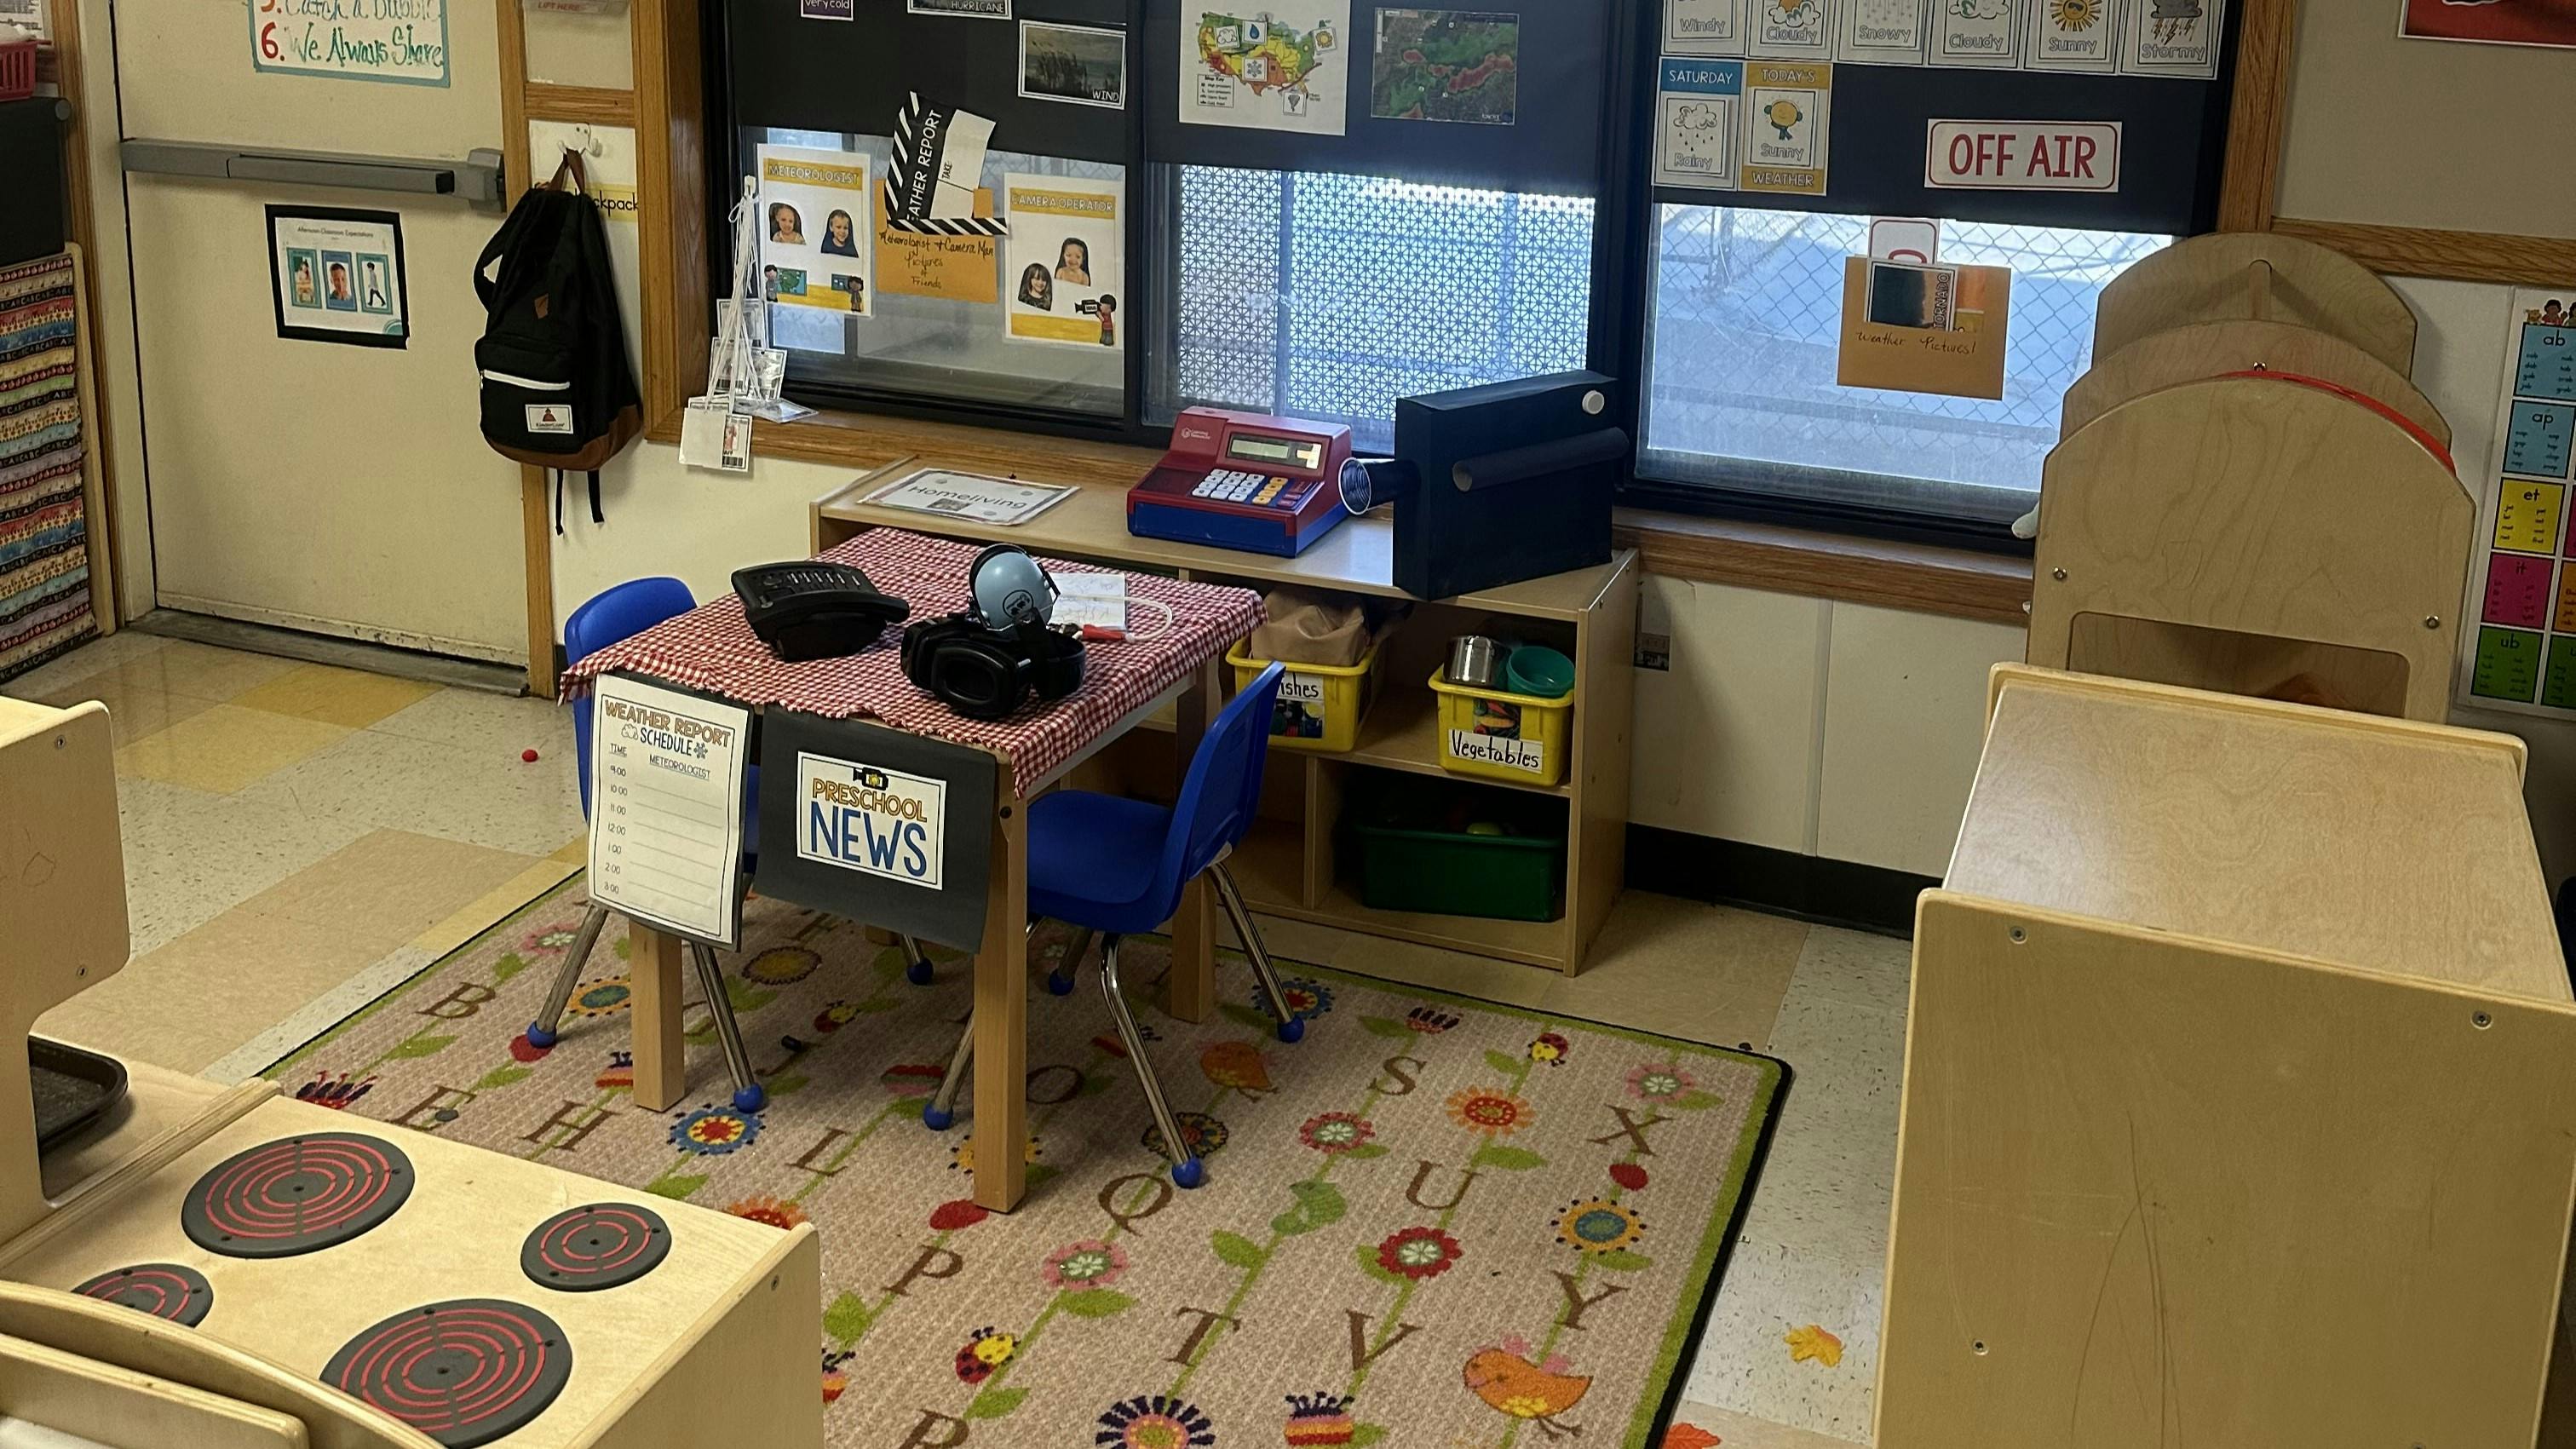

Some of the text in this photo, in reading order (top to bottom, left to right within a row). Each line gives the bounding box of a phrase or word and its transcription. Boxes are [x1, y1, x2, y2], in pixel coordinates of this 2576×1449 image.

[951, 1, 1004, 13] HURRICANE
[1680, 18, 1726, 33] Windy
[1766, 26, 1817, 43] Cloudy
[1859, 26, 1911, 43] Snowy
[261, 21, 285, 61] 6.
[326, 26, 388, 66] Always
[391, 24, 445, 67] Share
[1949, 33, 2004, 51] Cloudy
[2048, 37, 2097, 54] Sunny
[2142, 43, 2205, 60] Stormy
[1669, 70, 1733, 83] SATURDAY
[1762, 68, 1816, 83] TODAY'S
[1092, 89, 1119, 101] WIND
[917, 109, 943, 167] REPORT
[1674, 152, 1712, 170] Rainy
[1761, 143, 1804, 161] Sunny
[1949, 134, 2097, 179] OFF AIR
[768, 164, 859, 185] METEOROLOGIST
[1752, 172, 1814, 187] WEATHER
[1011, 193, 1113, 212] CAMERA OPERATOR
[945, 238, 975, 254] Camera
[977, 240, 994, 259] Man
[1933, 273, 1951, 329] TORNADO
[2543, 330, 2566, 347] ab
[2532, 412, 2554, 430] ap
[907, 486, 1026, 509] Homeliving
[2523, 488, 2540, 502] et
[2515, 561, 2527, 577] it
[2500, 634, 2520, 650] ub
[1280, 672, 1320, 698] ishes
[605, 699, 732, 748] WEATHER REPORT
[610, 743, 628, 755] TIME
[640, 727, 693, 756] SCHEDULE
[1452, 729, 1539, 768] Vegetables
[649, 754, 711, 779] METEOROLOGIST
[812, 778, 928, 823] PRESCHOOL
[811, 801, 927, 877] NEWS
[416, 981, 496, 1020] B
[1369, 1056, 1427, 1095] S
[383, 1084, 477, 1131] E
[519, 1099, 622, 1151] H
[1588, 1105, 1673, 1157] X
[785, 1127, 852, 1177] L
[1406, 1160, 1481, 1210] U
[1098, 1172, 1173, 1237] Q
[881, 1245, 963, 1296] P
[1551, 1270, 1630, 1331] Y
[1166, 1307, 1241, 1365] T
[1345, 1309, 1422, 1370] V
